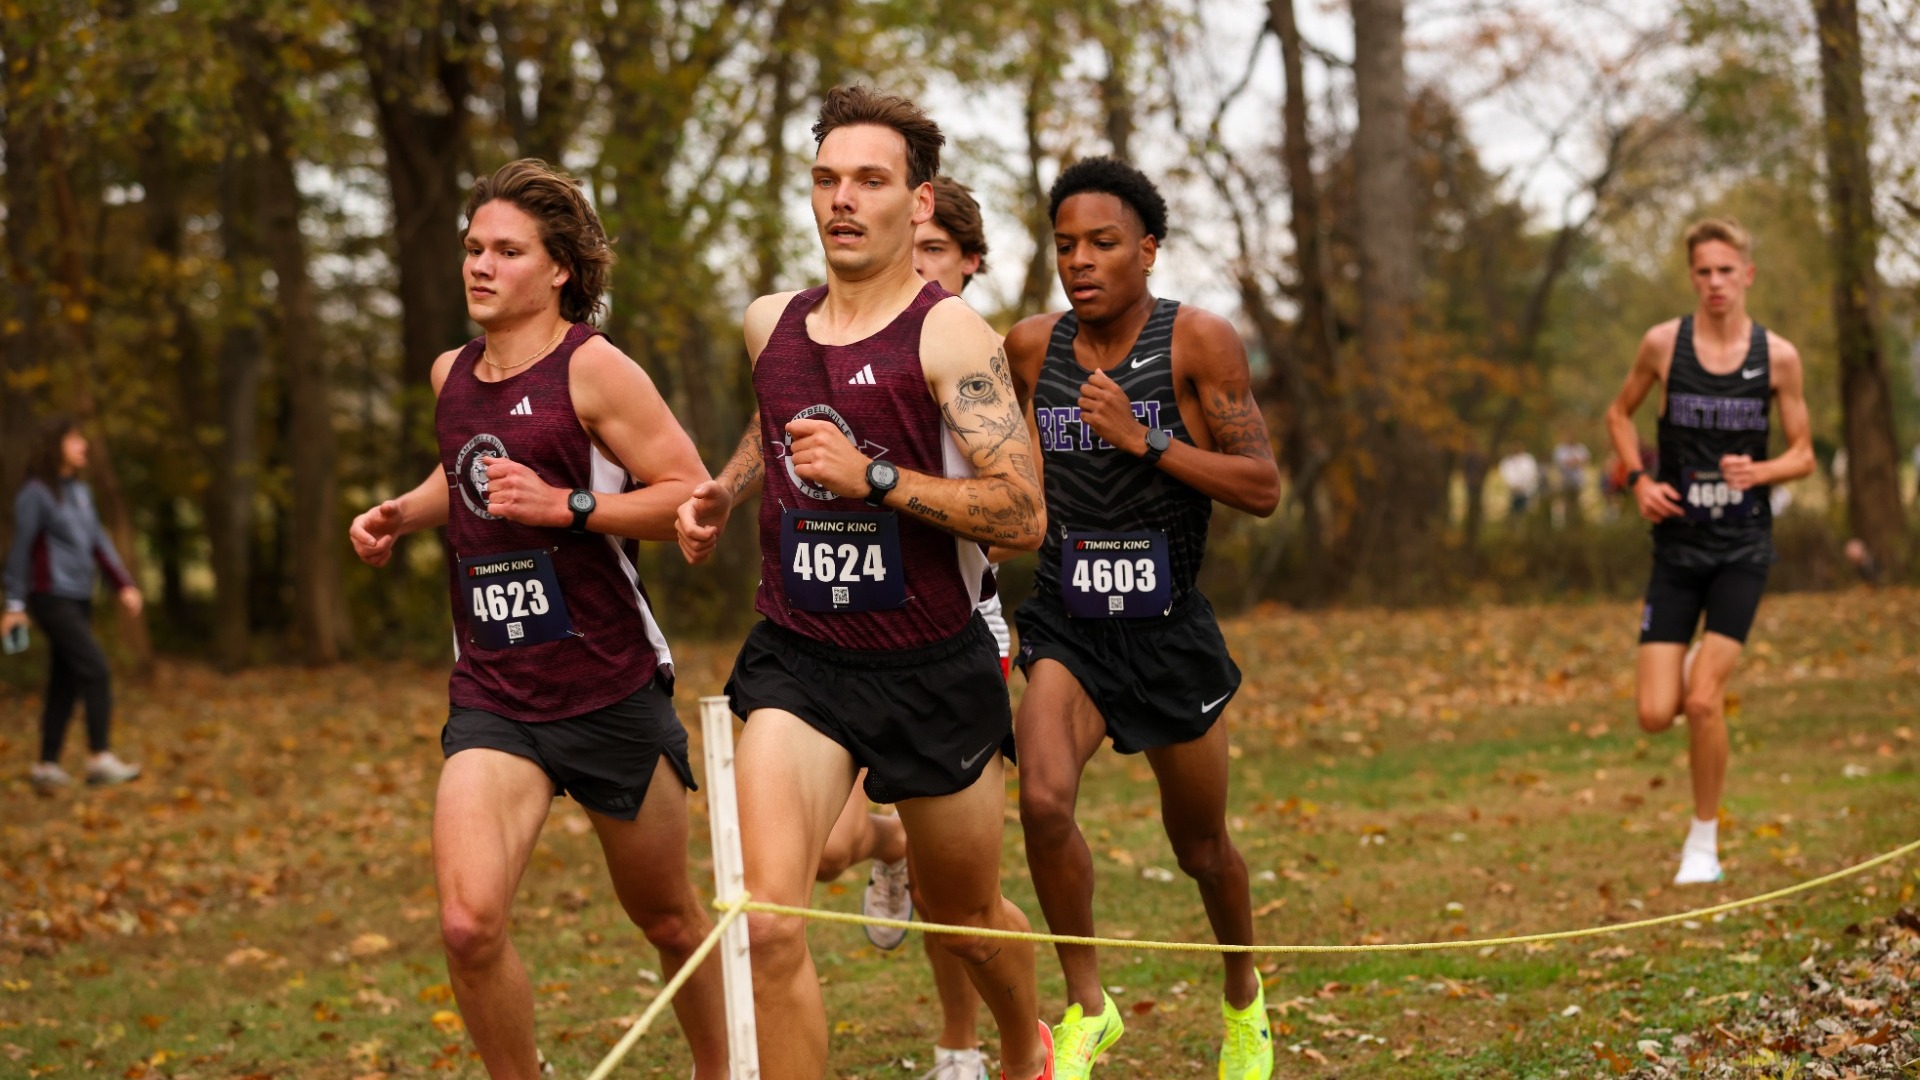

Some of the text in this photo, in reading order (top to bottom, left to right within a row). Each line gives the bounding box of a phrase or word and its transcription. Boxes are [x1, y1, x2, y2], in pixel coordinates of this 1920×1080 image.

[1037, 400, 1174, 451] BETL
[1669, 392, 1768, 432] BETHEL
[847, 522, 877, 532] KING
[1123, 540, 1150, 550] KING
[511, 559, 534, 571] KING
[793, 542, 887, 583] 4624
[1072, 558, 1157, 593] 4603
[472, 579, 550, 622] 4623
